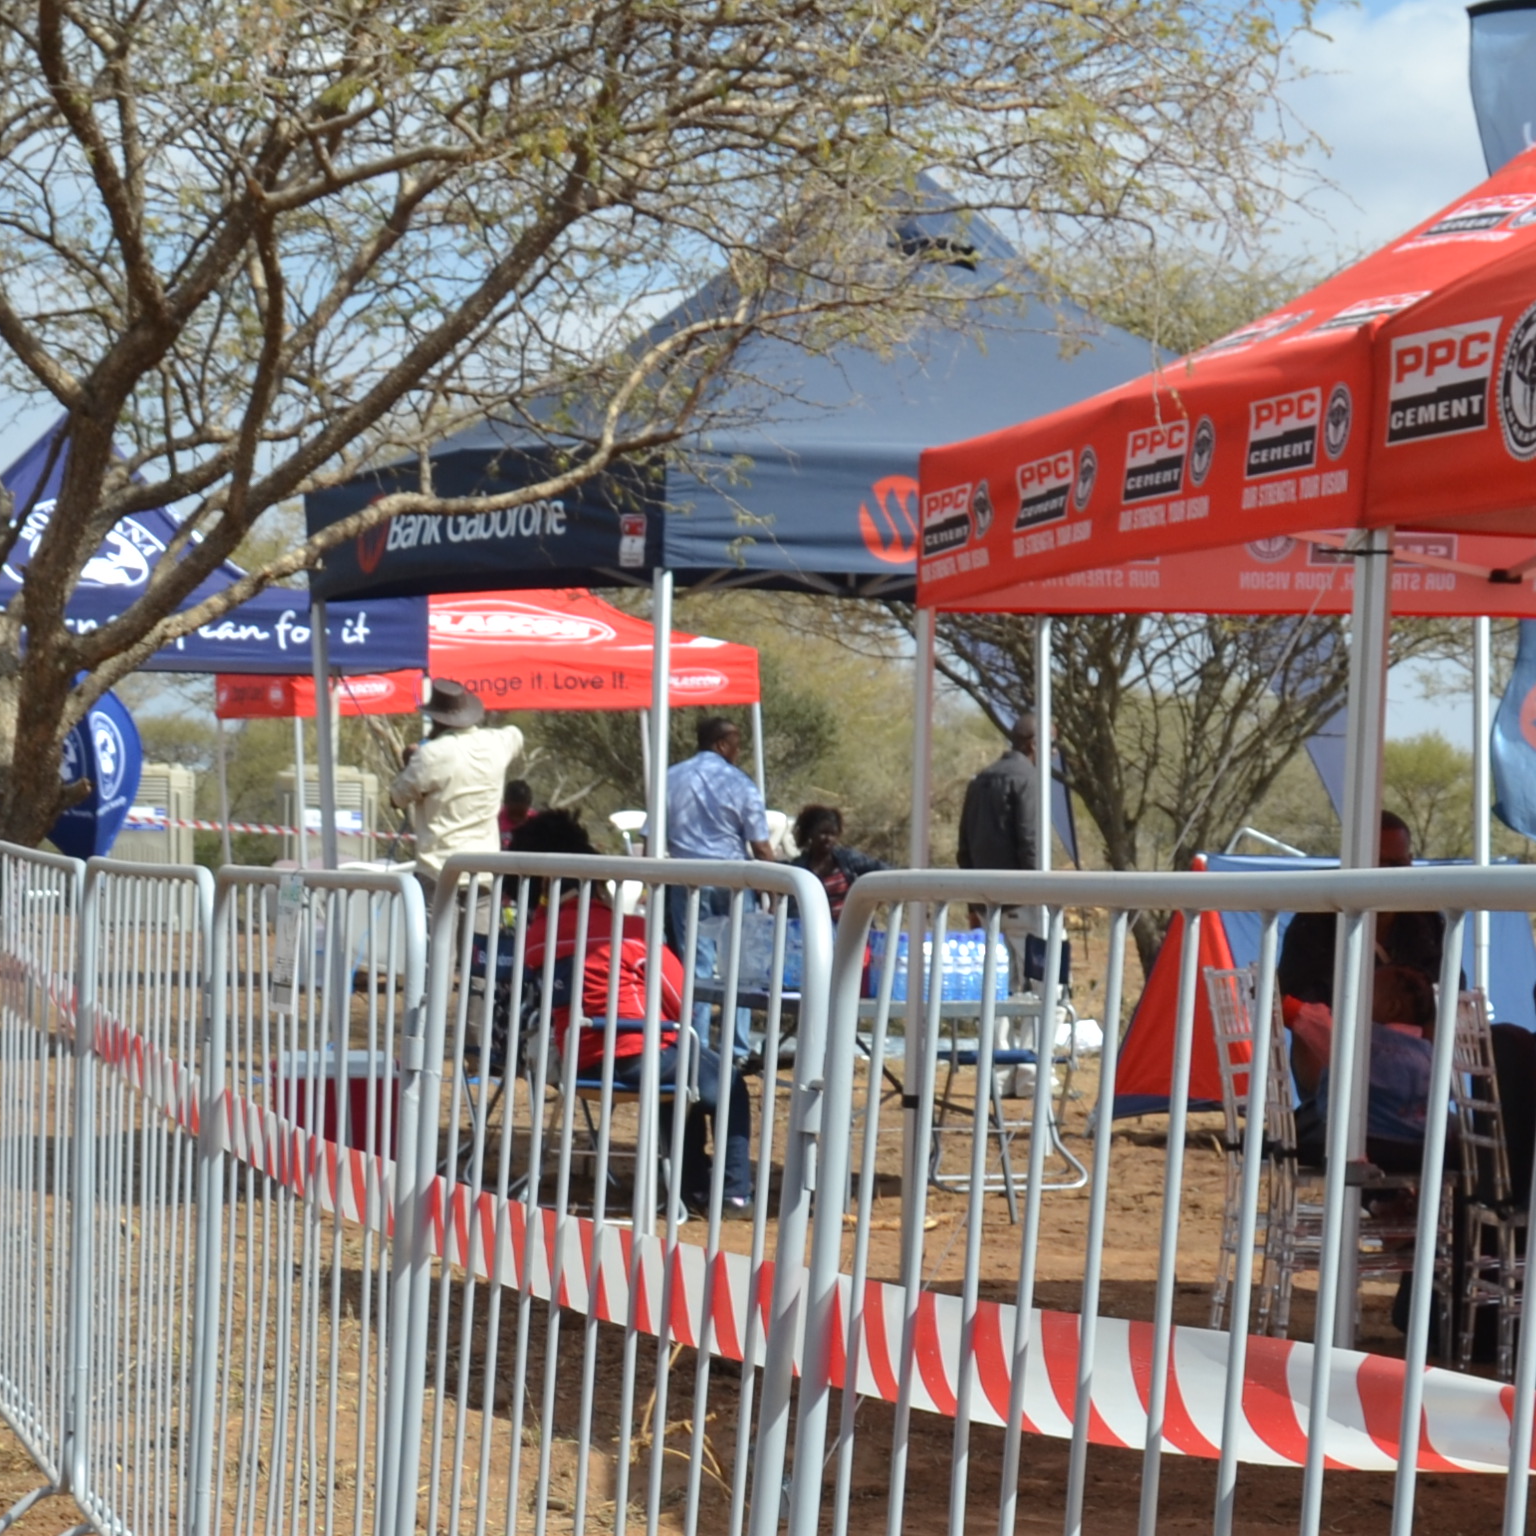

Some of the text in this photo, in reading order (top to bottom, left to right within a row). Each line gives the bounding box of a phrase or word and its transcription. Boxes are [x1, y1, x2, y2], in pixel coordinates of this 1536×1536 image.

[1394, 331, 1492, 384] PPC
[1254, 392, 1317, 430] PPC
[1390, 395, 1484, 430] CEMENT
[1131, 424, 1186, 458] PPC
[1249, 440, 1313, 465] CEMENT
[1020, 455, 1071, 490] PPC
[1126, 468, 1181, 491] CEMENT
[926, 487, 967, 517] PPC
[1019, 496, 1065, 519] CEMENT
[387, 514, 442, 551] Bank
[924, 524, 969, 547] CEMENT
[275, 610, 331, 650] fo
[342, 611, 371, 644] it
[553, 671, 604, 690] Love
